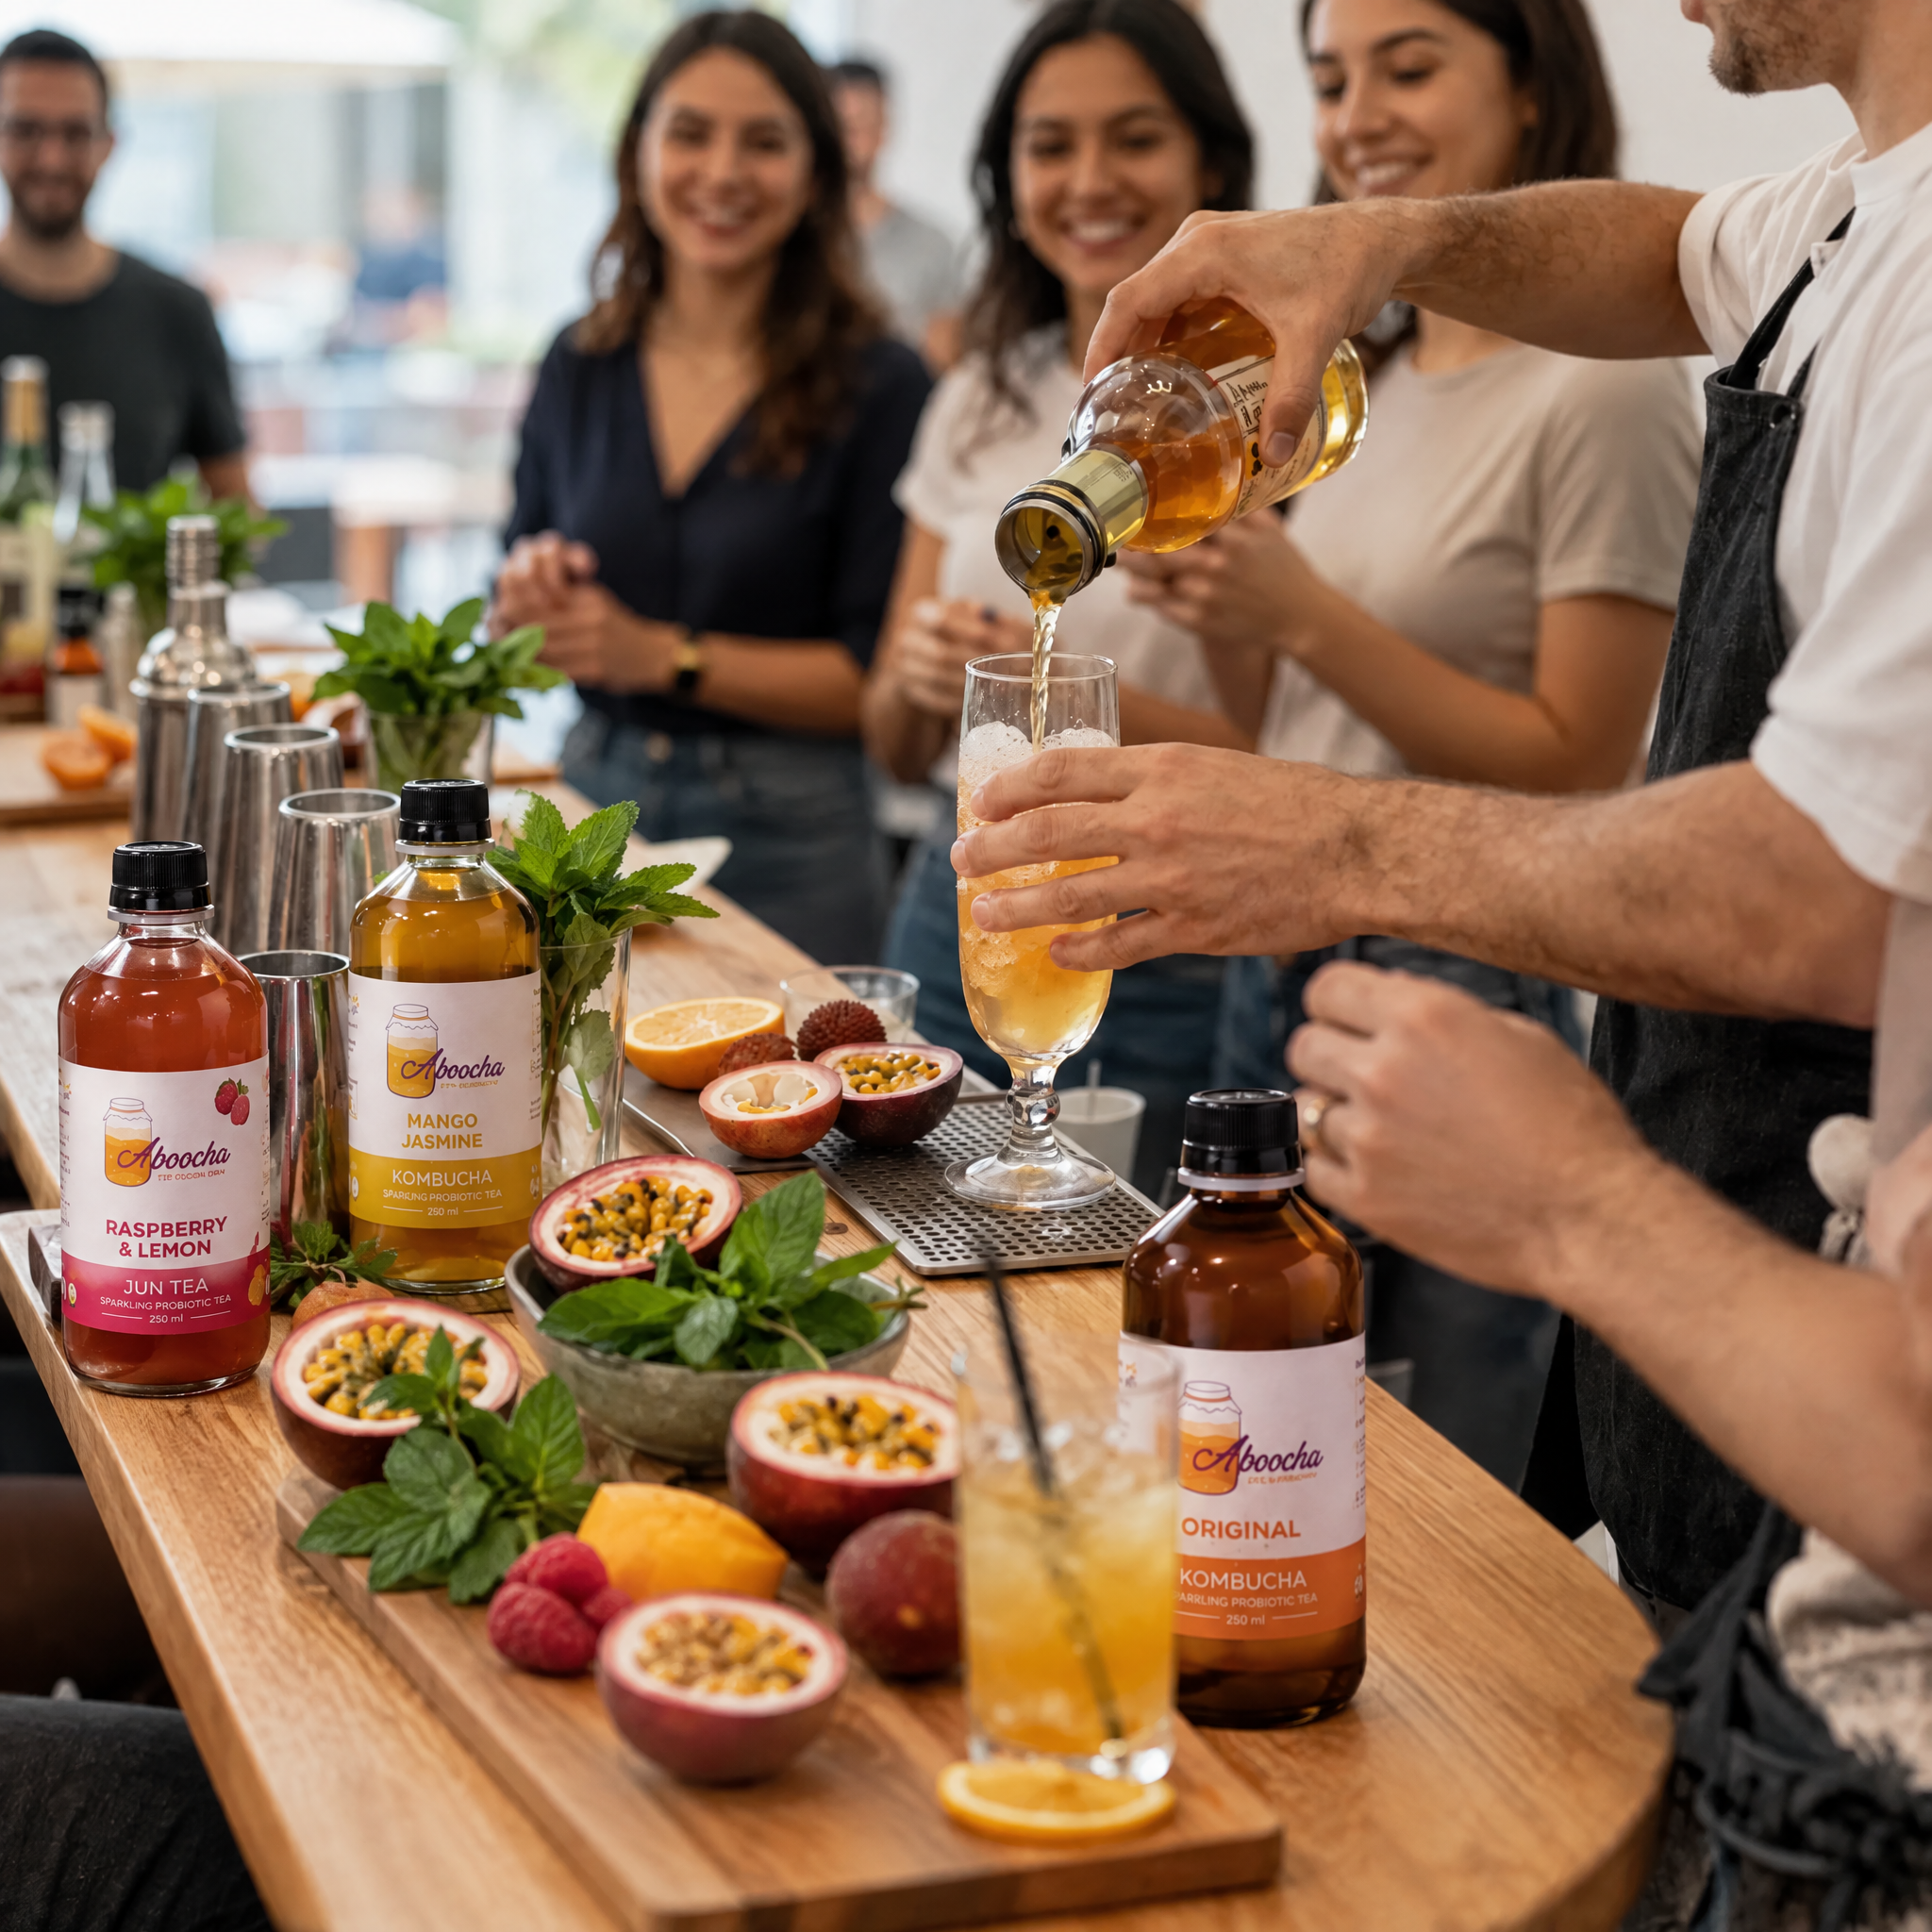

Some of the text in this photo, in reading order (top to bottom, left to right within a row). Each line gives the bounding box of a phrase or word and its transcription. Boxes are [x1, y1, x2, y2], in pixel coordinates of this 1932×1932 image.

[400, 1047, 506, 1080] Aboocha
[408, 1112, 478, 1129] MANGO
[401, 1133, 483, 1150] JASMINE
[116, 1136, 231, 1170] Aboocha
[392, 1169, 492, 1187] KOMBUCHA
[429, 1191, 483, 1203] PROBIOTIC
[485, 1189, 503, 1199] TEA
[447, 1207, 458, 1216] ml
[106, 1215, 228, 1239] RASPBERRY
[119, 1239, 211, 1258] & LEMON
[124, 1277, 208, 1295] JUN TEA
[100, 1294, 232, 1310] SPARKLING PROBIOTIC TEA
[149, 1313, 183, 1324] 250 ml
[1192, 1434, 1324, 1473] Aboocha
[1181, 1517, 1301, 1540] ORIGINAL
[1179, 1567, 1307, 1591] KOMBUCHA
[1231, 1595, 1295, 1608] PROBIOTIC
[1297, 1591, 1319, 1604] TEA
[1225, 1614, 1266, 1625] 250 ml
